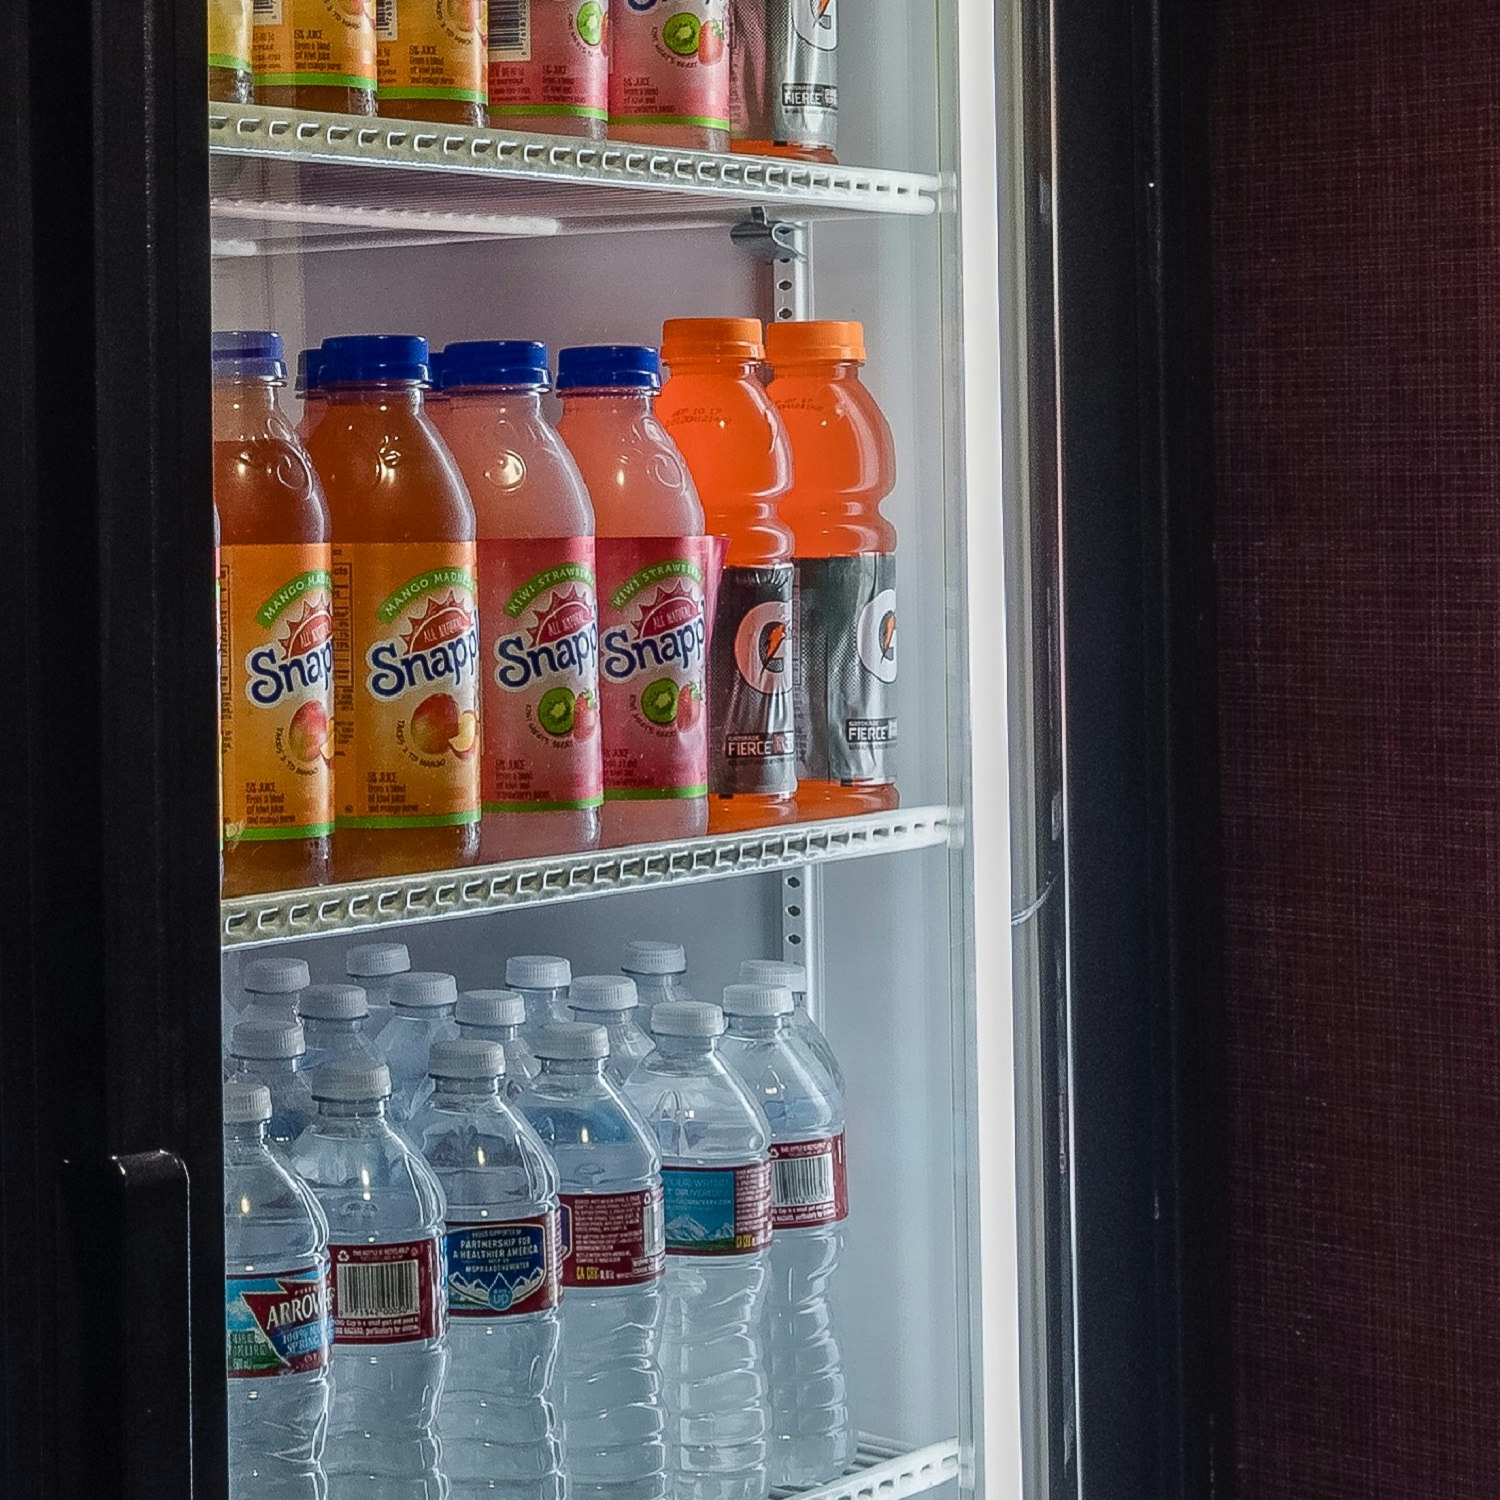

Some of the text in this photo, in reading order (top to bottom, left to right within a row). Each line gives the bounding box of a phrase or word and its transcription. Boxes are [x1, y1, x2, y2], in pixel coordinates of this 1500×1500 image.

[263, 580, 305, 620] MANGO
[386, 578, 429, 616] MANGO
[508, 585, 536, 613] KIWI
[613, 579, 638, 608] KIWI
[499, 622, 596, 687] Snapp
[849, 727, 887, 741] FIERCE
[728, 741, 772, 756] FIERCE
[460, 1237, 531, 1249] PARTNERSHIP FOR
[460, 1245, 538, 1258] HEALTHIER AMERICA
